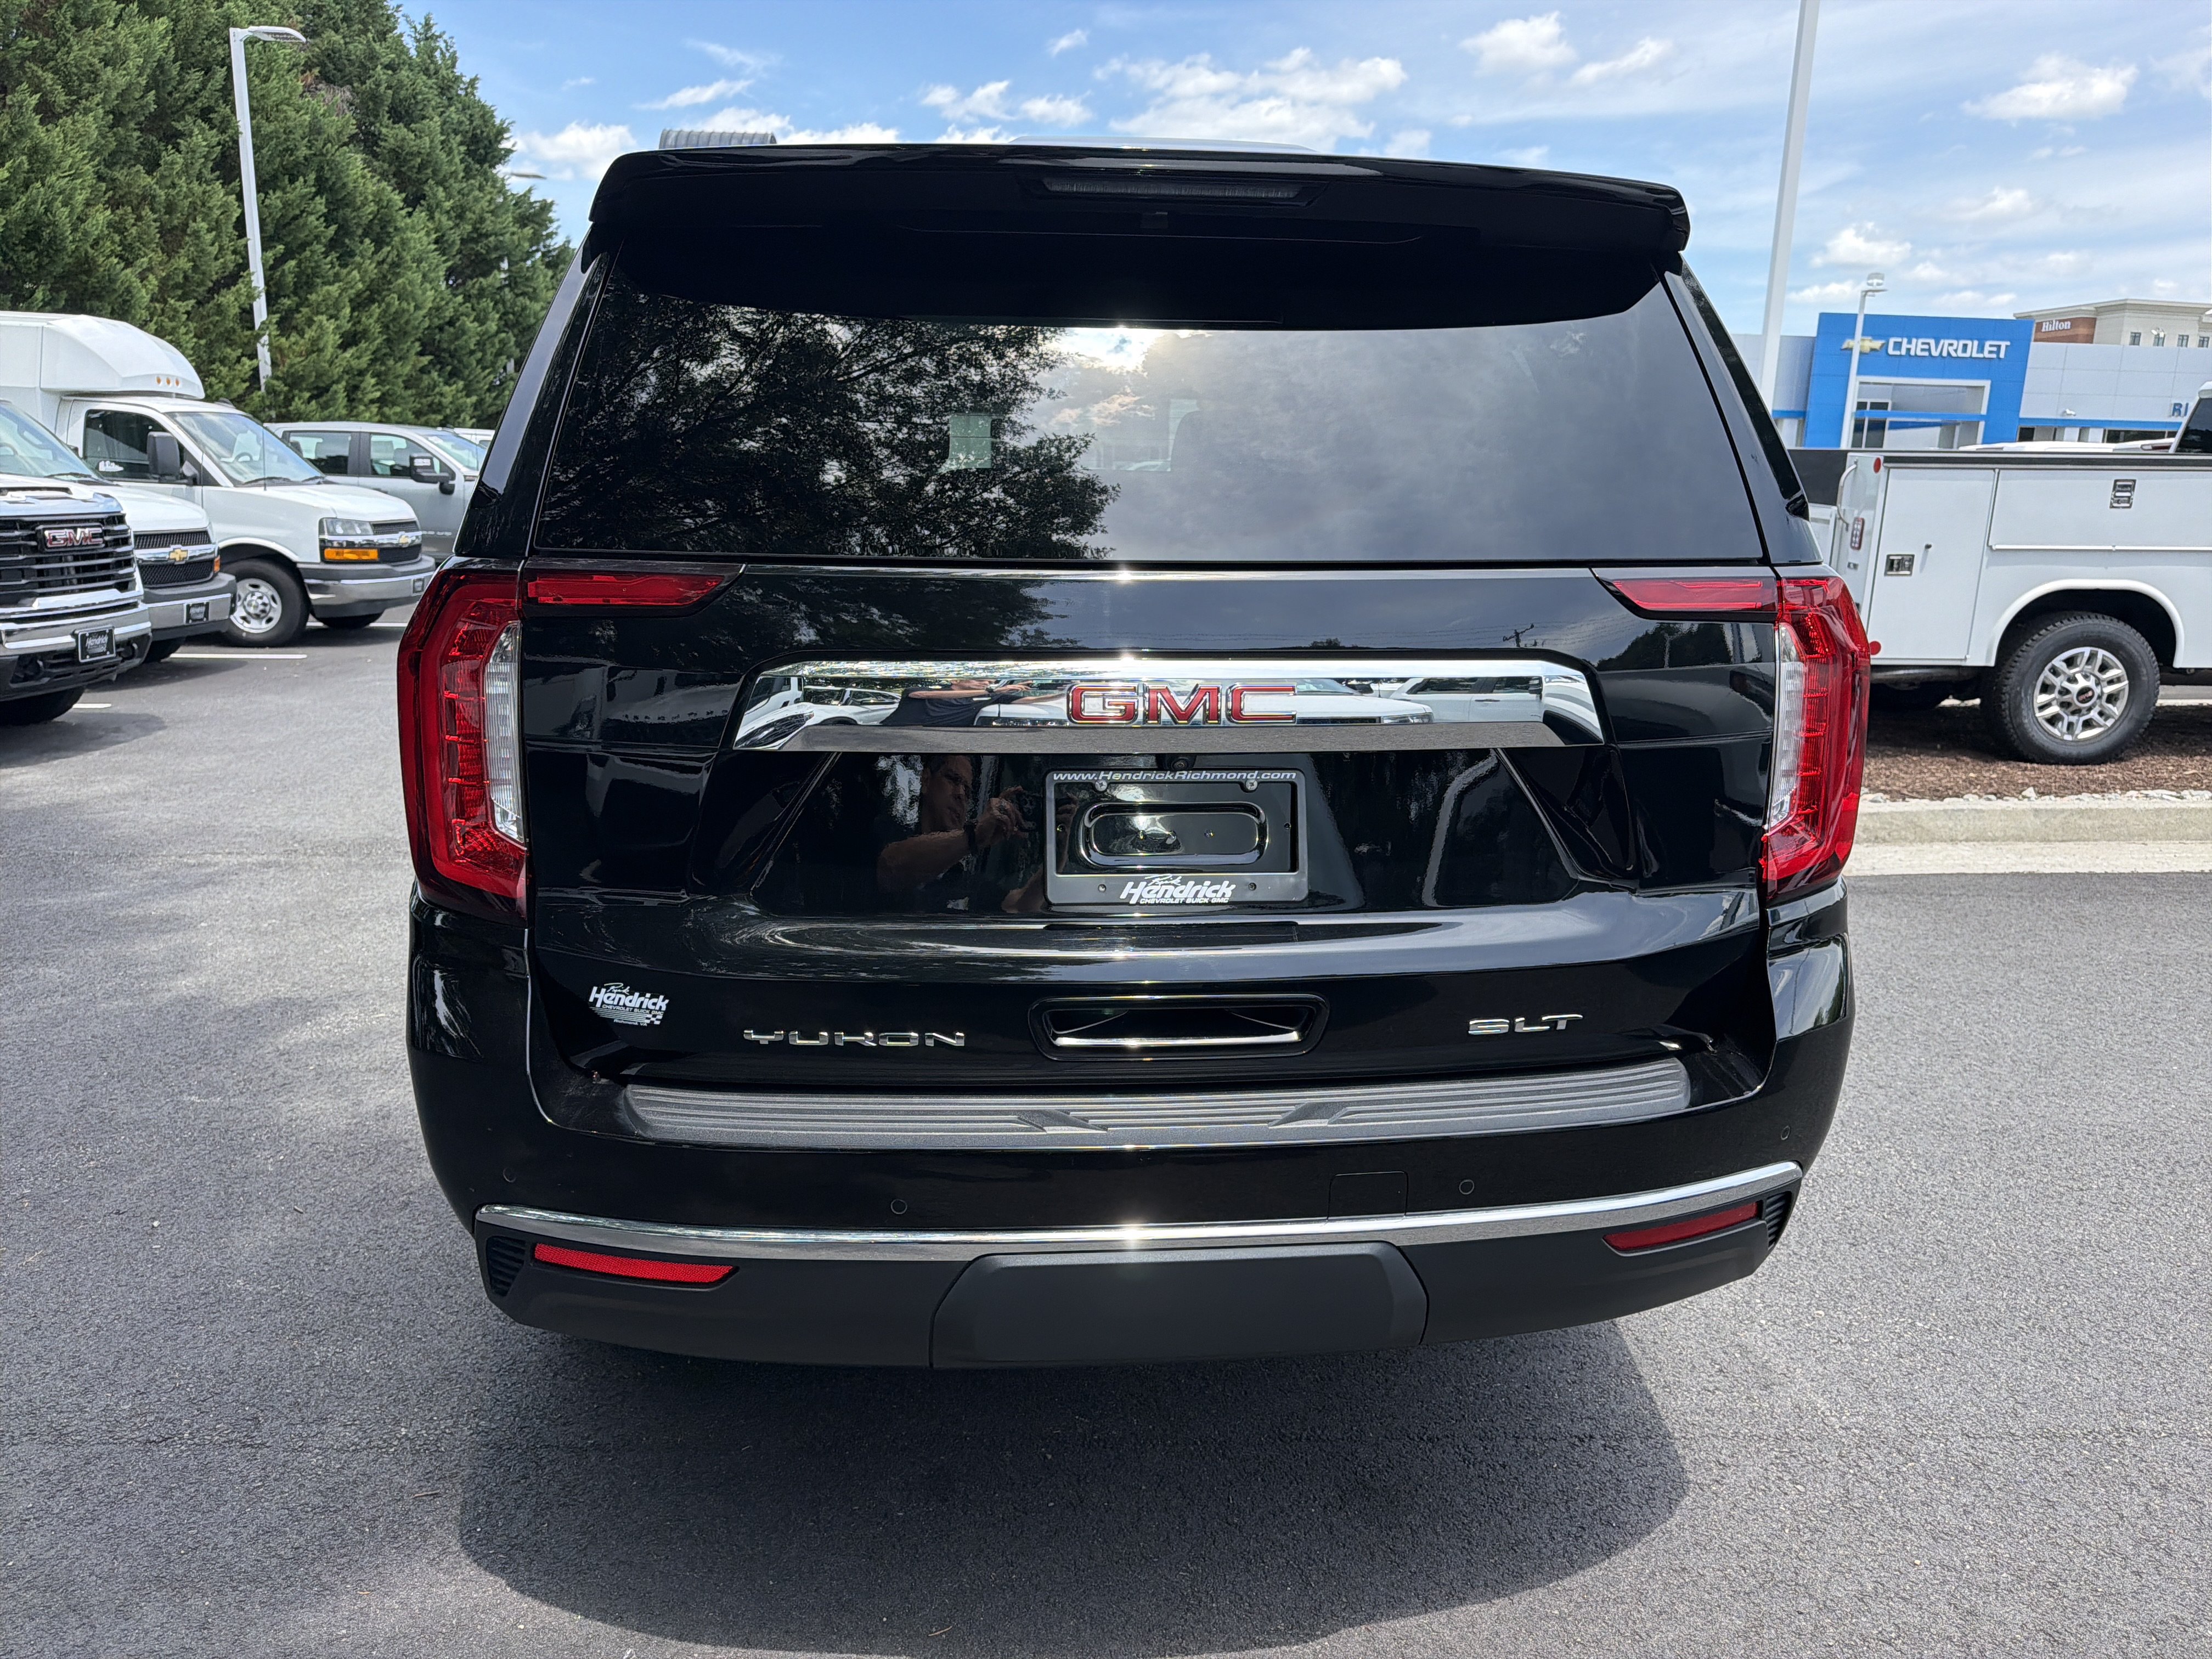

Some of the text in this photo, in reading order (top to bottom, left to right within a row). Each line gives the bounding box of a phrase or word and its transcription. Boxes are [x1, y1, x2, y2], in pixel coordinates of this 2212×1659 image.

[2041, 319, 2071, 332] Hilton
[1888, 337, 2011, 359] CHEVROLET
[44, 528, 103, 548] GMC
[1067, 682, 1297, 725] GMC
[1053, 770, 1296, 781] www.HendrickRichmond.com
[1120, 881, 1236, 904] Hendrick
[589, 986, 669, 1011] Hendrick
[1468, 1014, 1583, 1035] SLT
[743, 1029, 964, 1047] YUKON
